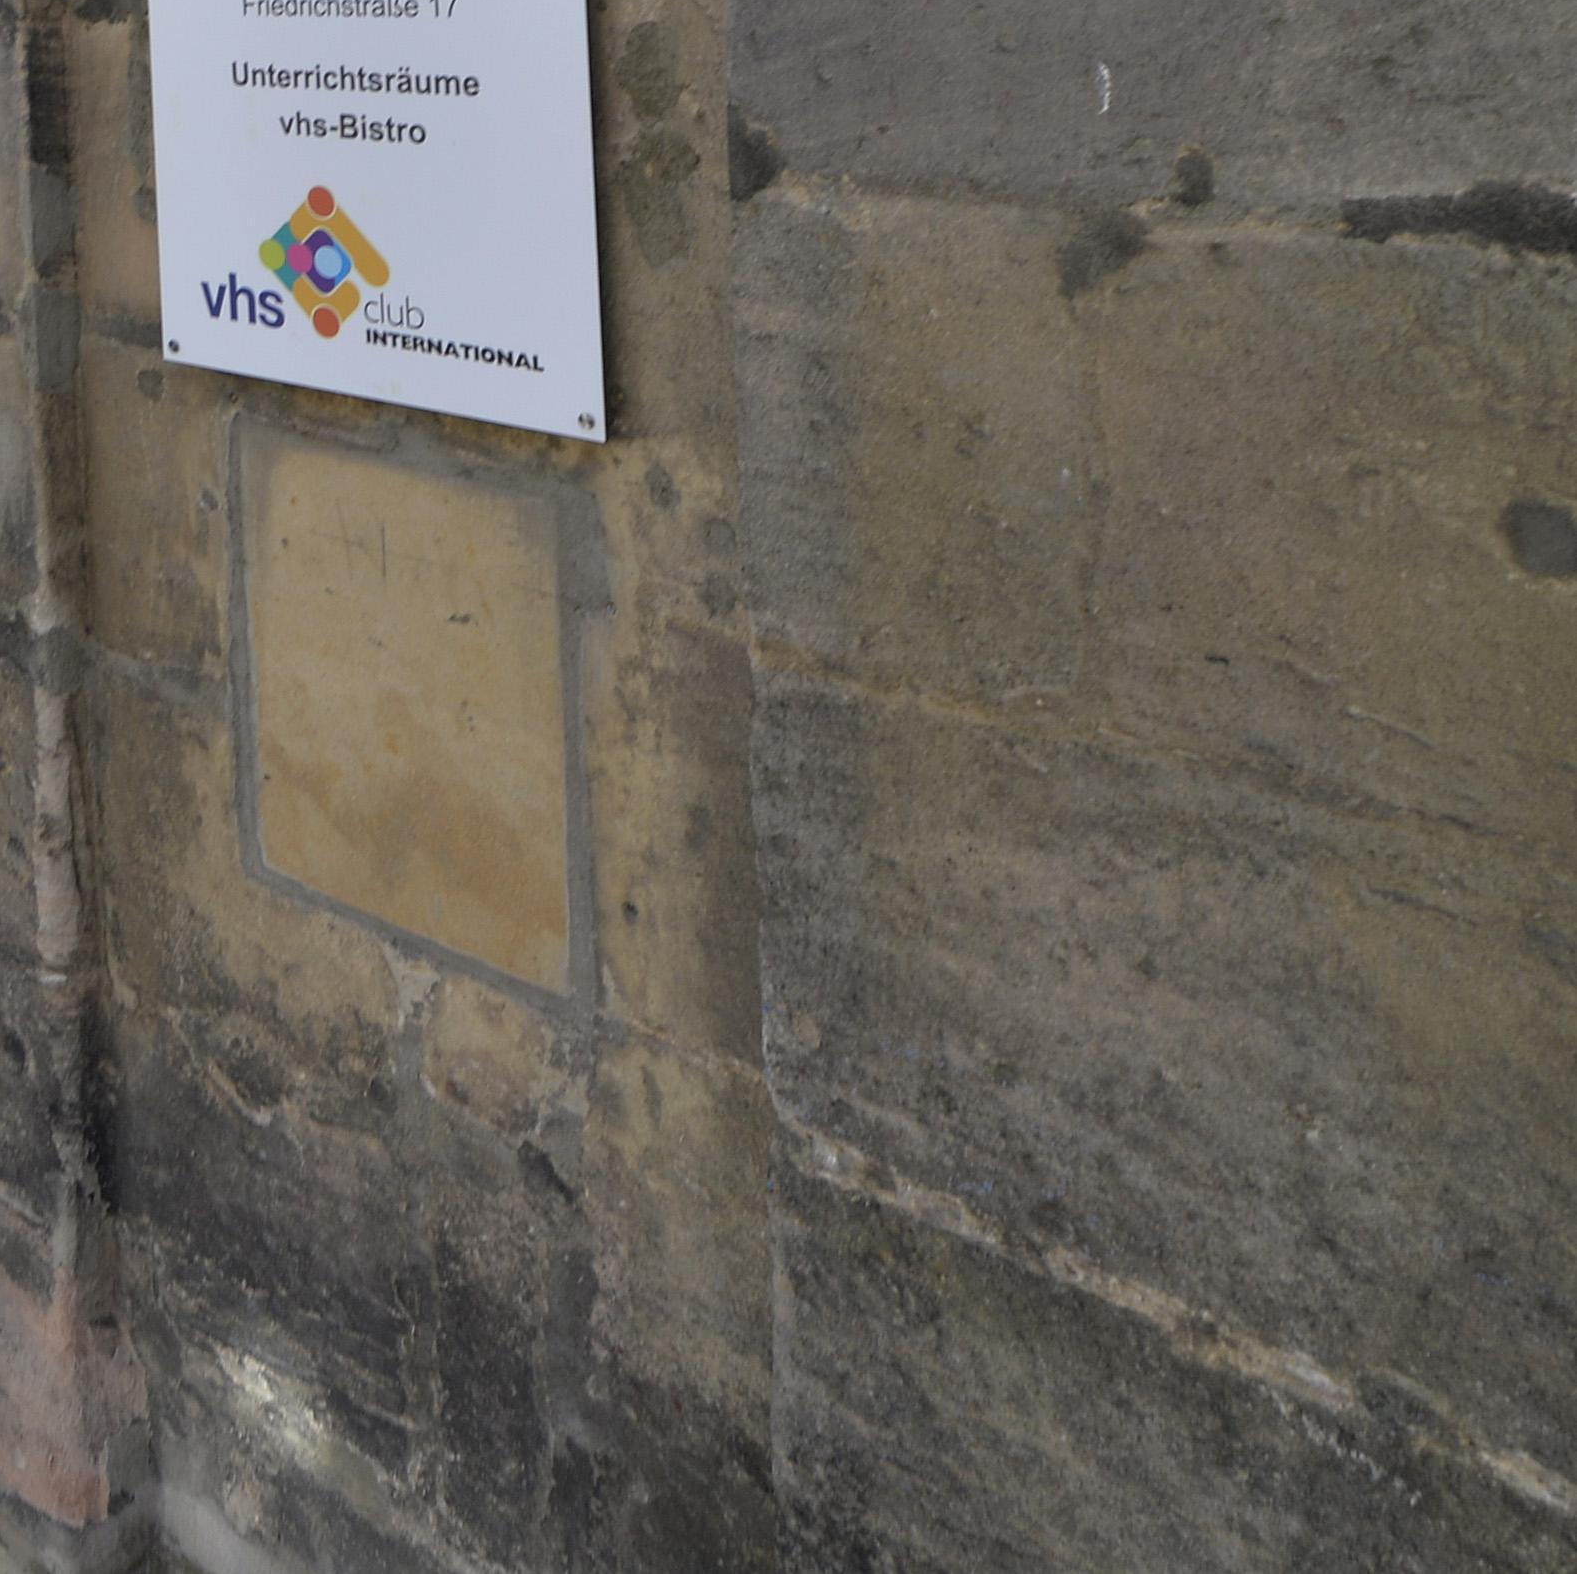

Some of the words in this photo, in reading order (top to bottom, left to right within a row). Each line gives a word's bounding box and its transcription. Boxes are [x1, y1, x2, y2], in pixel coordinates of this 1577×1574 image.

[231, 61, 480, 97] Unterrichtsräume
[279, 111, 427, 144] vhs-Bistro
[201, 272, 285, 328] vhs
[363, 293, 425, 331] club
[365, 328, 545, 372] INTERNATIONAL
